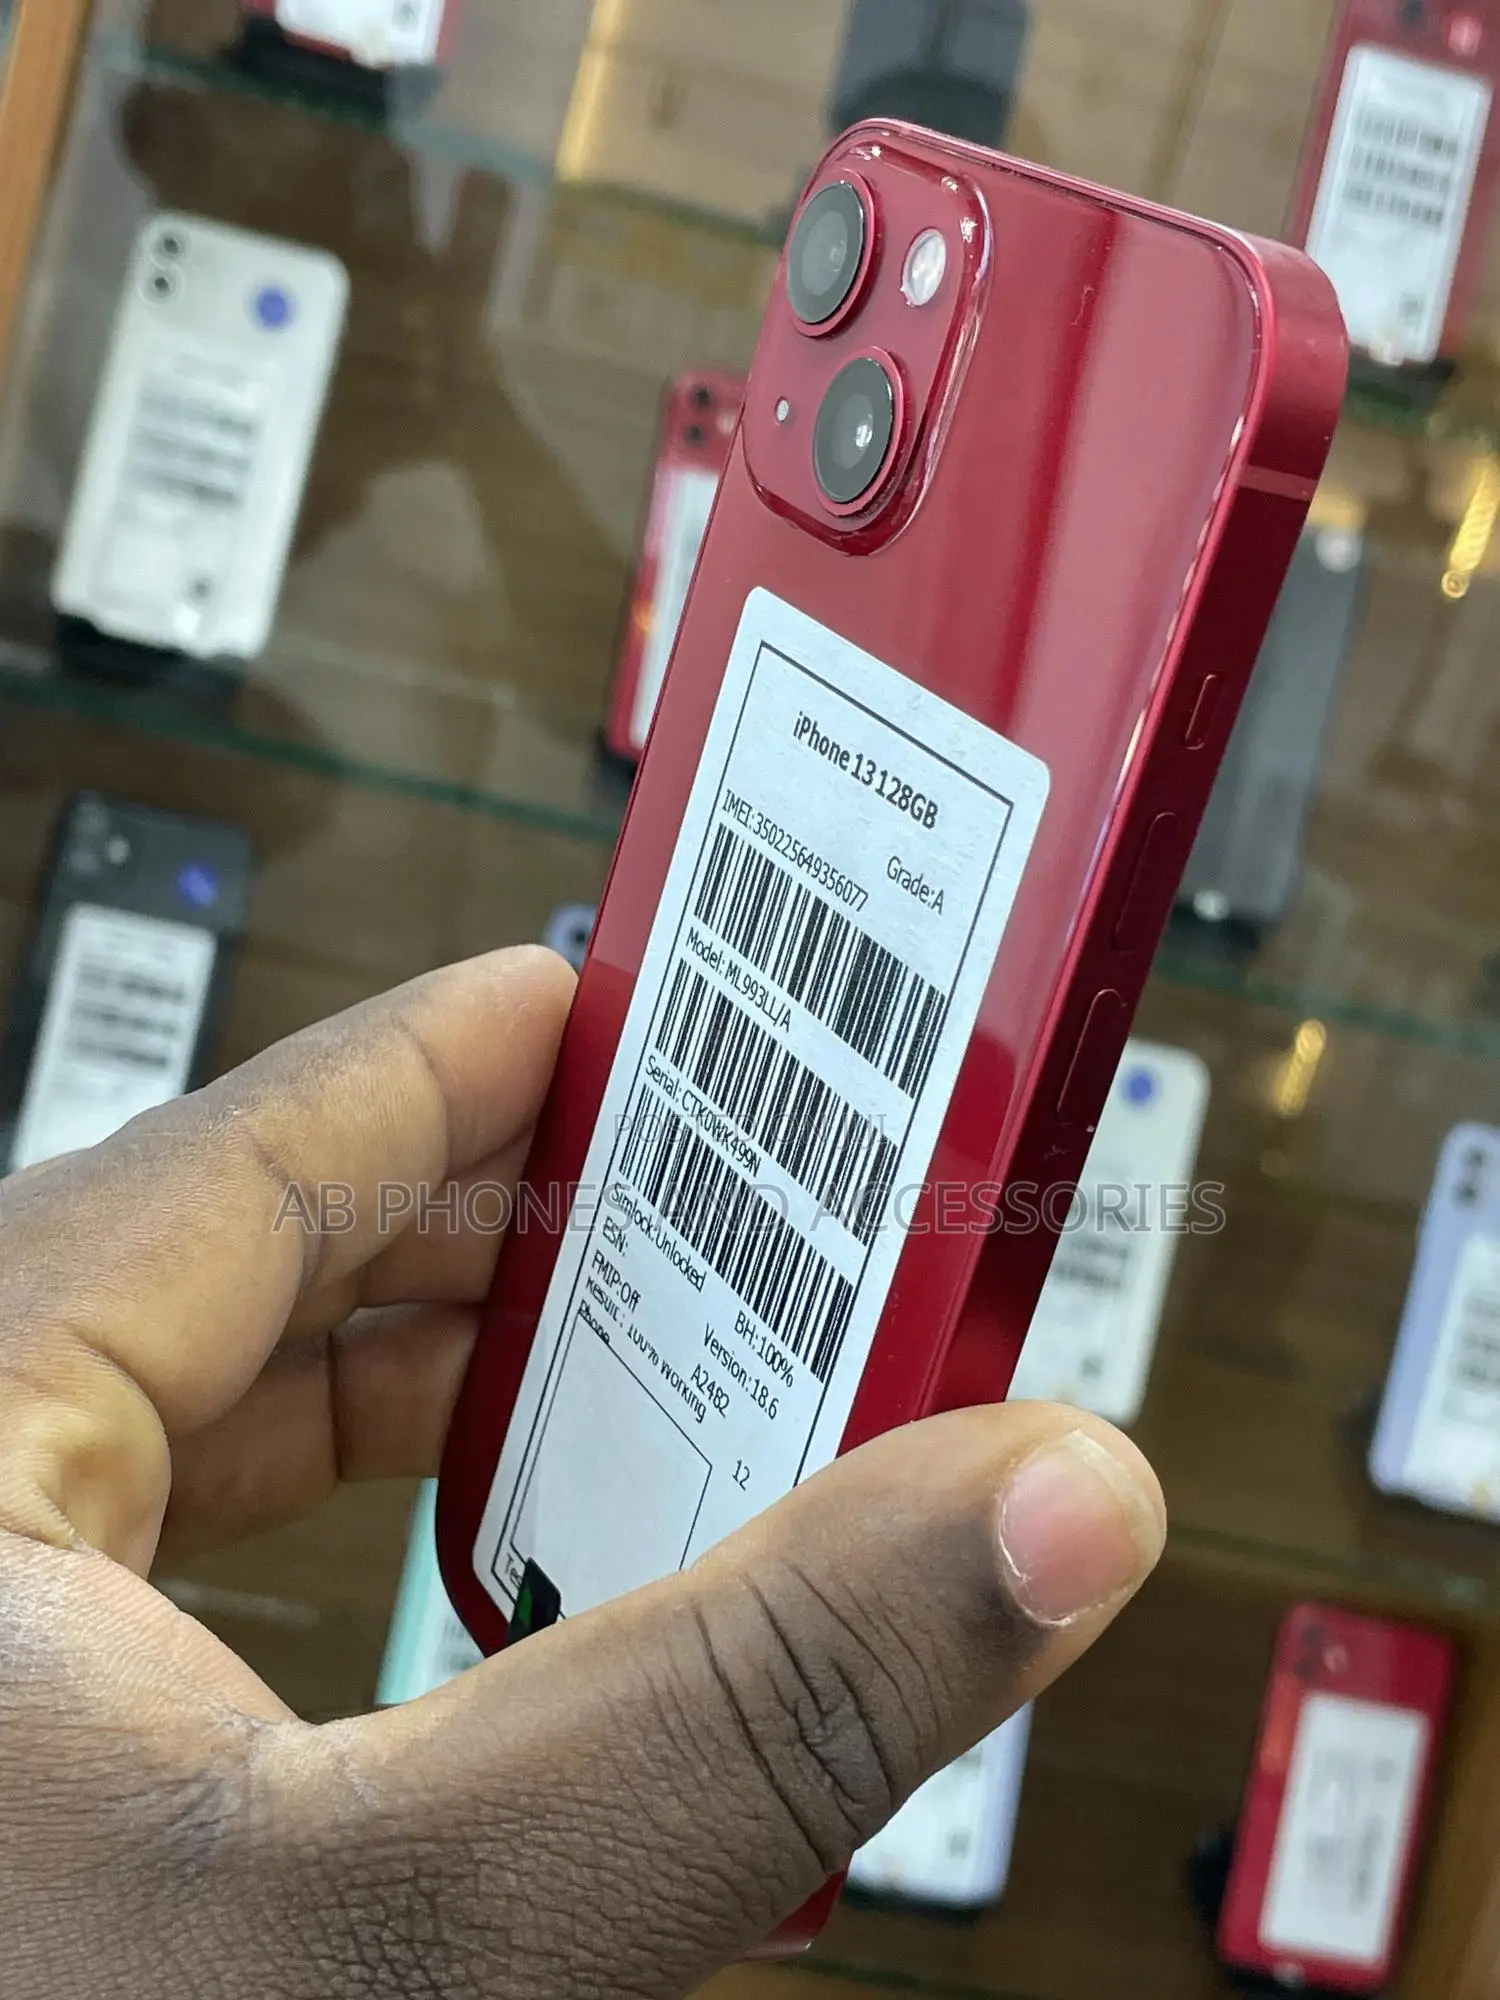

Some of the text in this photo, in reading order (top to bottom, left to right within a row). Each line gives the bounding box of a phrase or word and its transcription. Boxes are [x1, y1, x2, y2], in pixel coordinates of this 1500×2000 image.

[793, 711, 939, 830] iPhone 13 128GB
[887, 855, 945, 916] Grade:A
[685, 926, 792, 1033] Model: ML993LL/A
[645, 1054, 682, 1103] Serial:
[602, 1216, 629, 1256] ESN:
[611, 1181, 707, 1293] Simlock:Unlocked
[591, 1249, 642, 1314] FMIP:Off
[704, 1323, 780, 1420] Version:18.6
[734, 1309, 794, 1388] BH:100%
[690, 1363, 730, 1418] A2482
[731, 1459, 752, 1491] 12
